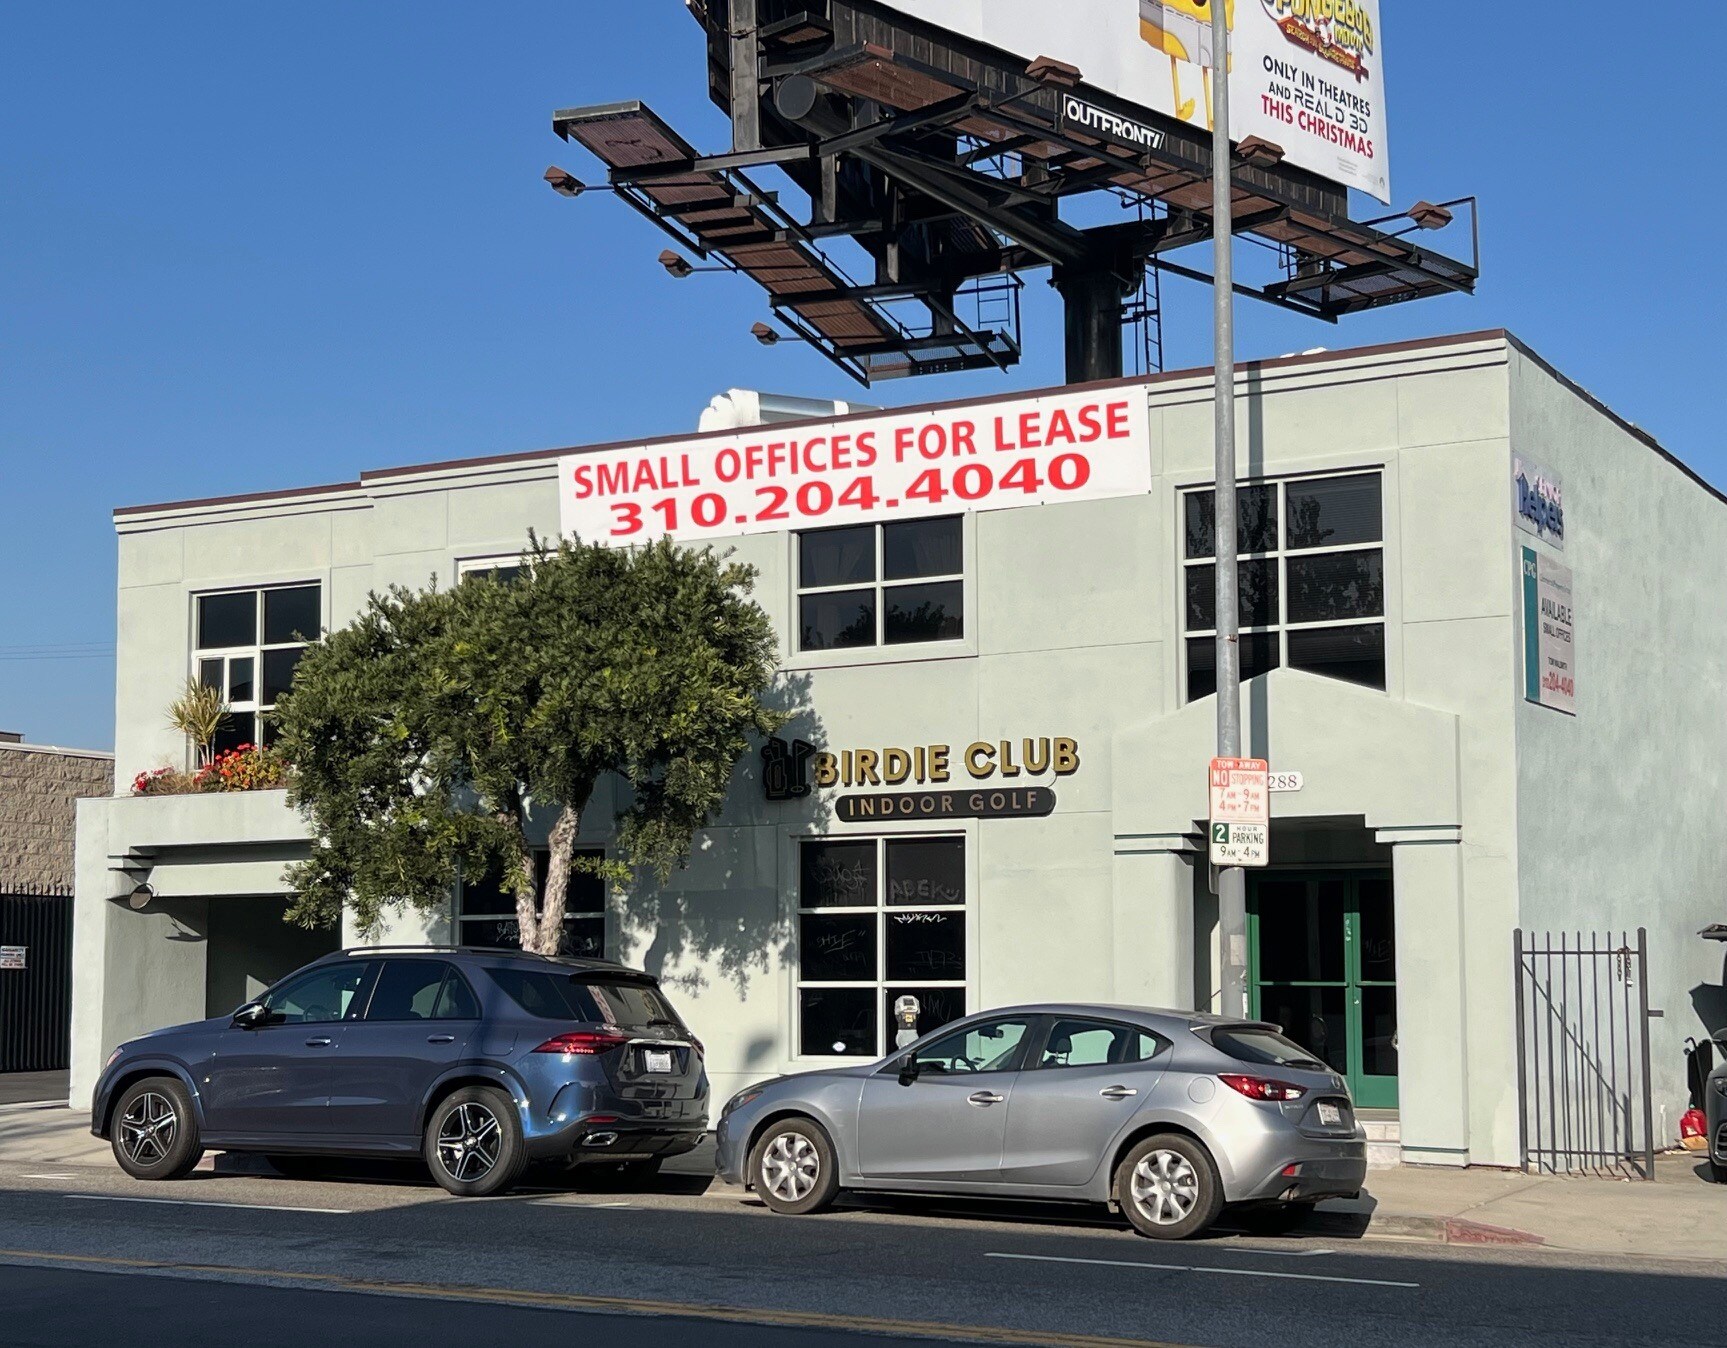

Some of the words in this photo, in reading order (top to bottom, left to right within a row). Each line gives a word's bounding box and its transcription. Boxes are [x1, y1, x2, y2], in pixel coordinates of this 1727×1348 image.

[1263, 55, 1298, 82] ONLY
[1302, 71, 1315, 91] IN
[1318, 79, 1371, 117] THEATRES
[1261, 94, 1294, 124] THIS
[1298, 110, 1374, 158] CHRISTMAS
[1269, 81, 1291, 100] AND
[1350, 113, 1368, 134] 3D
[575, 454, 700, 499] SMALL
[715, 431, 877, 483] OFFICES
[896, 420, 976, 463] FOR
[993, 400, 1131, 452] LEASE
[609, 452, 1092, 537] 310.204.4040
[1541, 597, 1572, 627] AVAILABLE
[815, 744, 951, 788] BIRDIE
[964, 737, 1080, 779] CLUB
[1213, 770, 1228, 786] NO
[1232, 773, 1264, 786] STOPPING
[1217, 760, 1234, 770] TOW
[1238, 761, 1261, 770] AWAY
[849, 795, 953, 816] INDOOR
[969, 791, 1037, 810] GOLF
[1216, 824, 1226, 842] 2
[1232, 833, 1264, 845] PARKING
